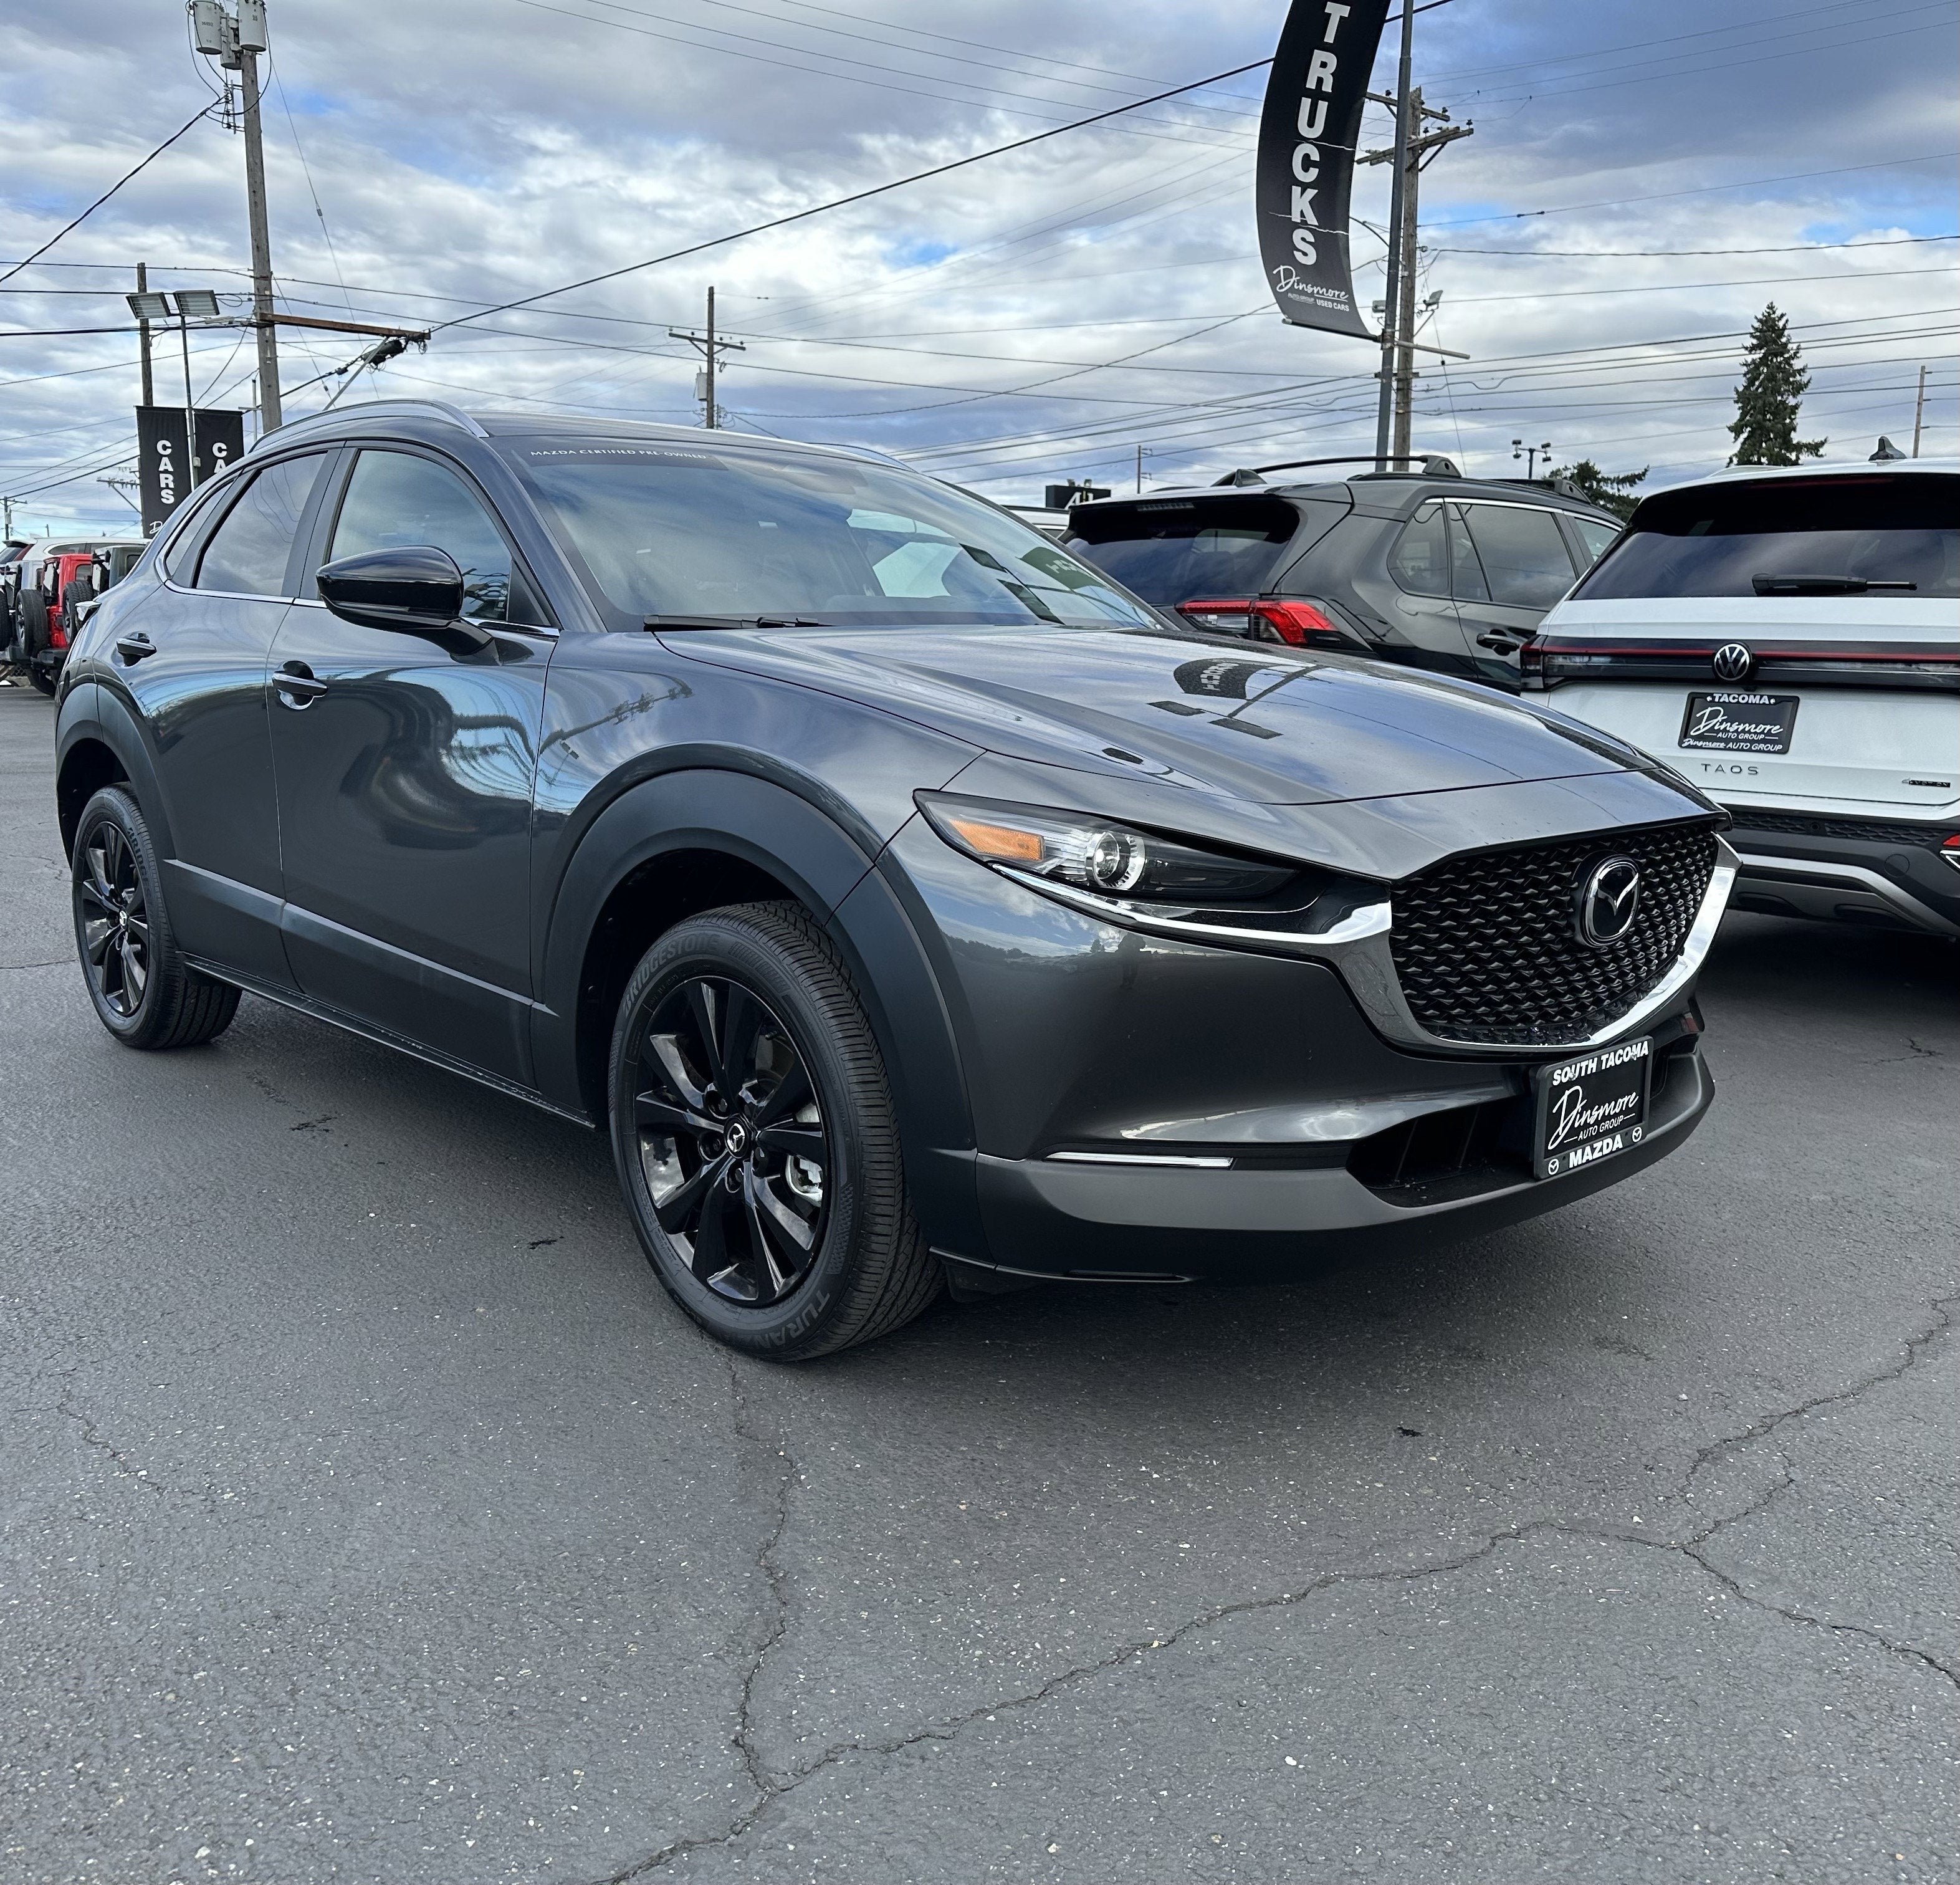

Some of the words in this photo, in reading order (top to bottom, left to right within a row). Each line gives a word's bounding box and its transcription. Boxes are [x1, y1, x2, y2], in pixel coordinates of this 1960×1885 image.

[1291, 1, 1350, 266] TRUCKS
[1273, 265, 1349, 299] Dinsmore
[1316, 299, 1332, 308] USED
[1333, 302, 1350, 312] CARS
[156, 439, 174, 504] CARS
[639, 450, 707, 459] PRE-OWNED
[1713, 693, 1769, 704] TACOMA
[1690, 706, 1784, 736] Dinsmore
[1751, 742, 1783, 752] GROUP
[1701, 763, 1759, 775] TAOS
[623, 933, 720, 1019] BRIDGESTONE
[1552, 1057, 1598, 1086] SOUTH
[1600, 1040, 1649, 1068] TACOMA
[1547, 1085, 1639, 1150] Dinsmore
[1577, 1123, 1597, 1141] AUTO
[1599, 1115, 1624, 1133] GROUP
[1569, 1134, 1623, 1168] MAZDA
[752, 1290, 831, 1349] TURAN
